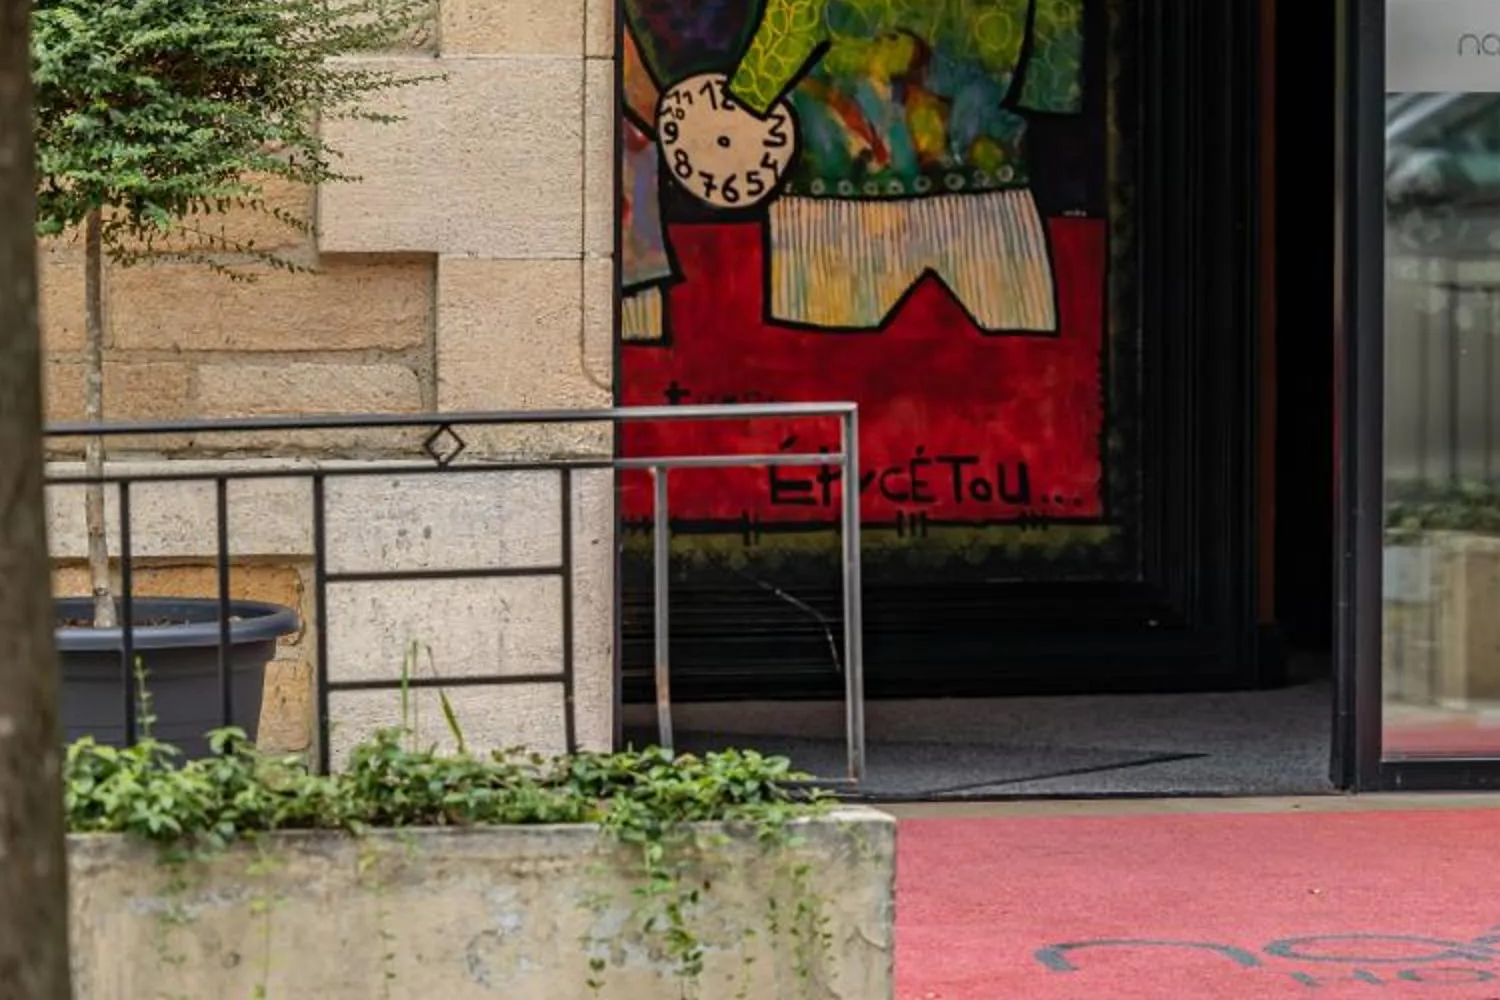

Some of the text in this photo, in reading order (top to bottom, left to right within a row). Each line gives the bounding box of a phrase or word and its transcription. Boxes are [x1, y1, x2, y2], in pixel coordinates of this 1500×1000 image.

[664, 121, 679, 144] 9
[762, 113, 787, 147] 3
[674, 148, 693, 178] 8
[760, 151, 780, 183] 4
[698, 170, 718, 198] 7
[721, 173, 740, 203] 6
[746, 171, 764, 196] 5
